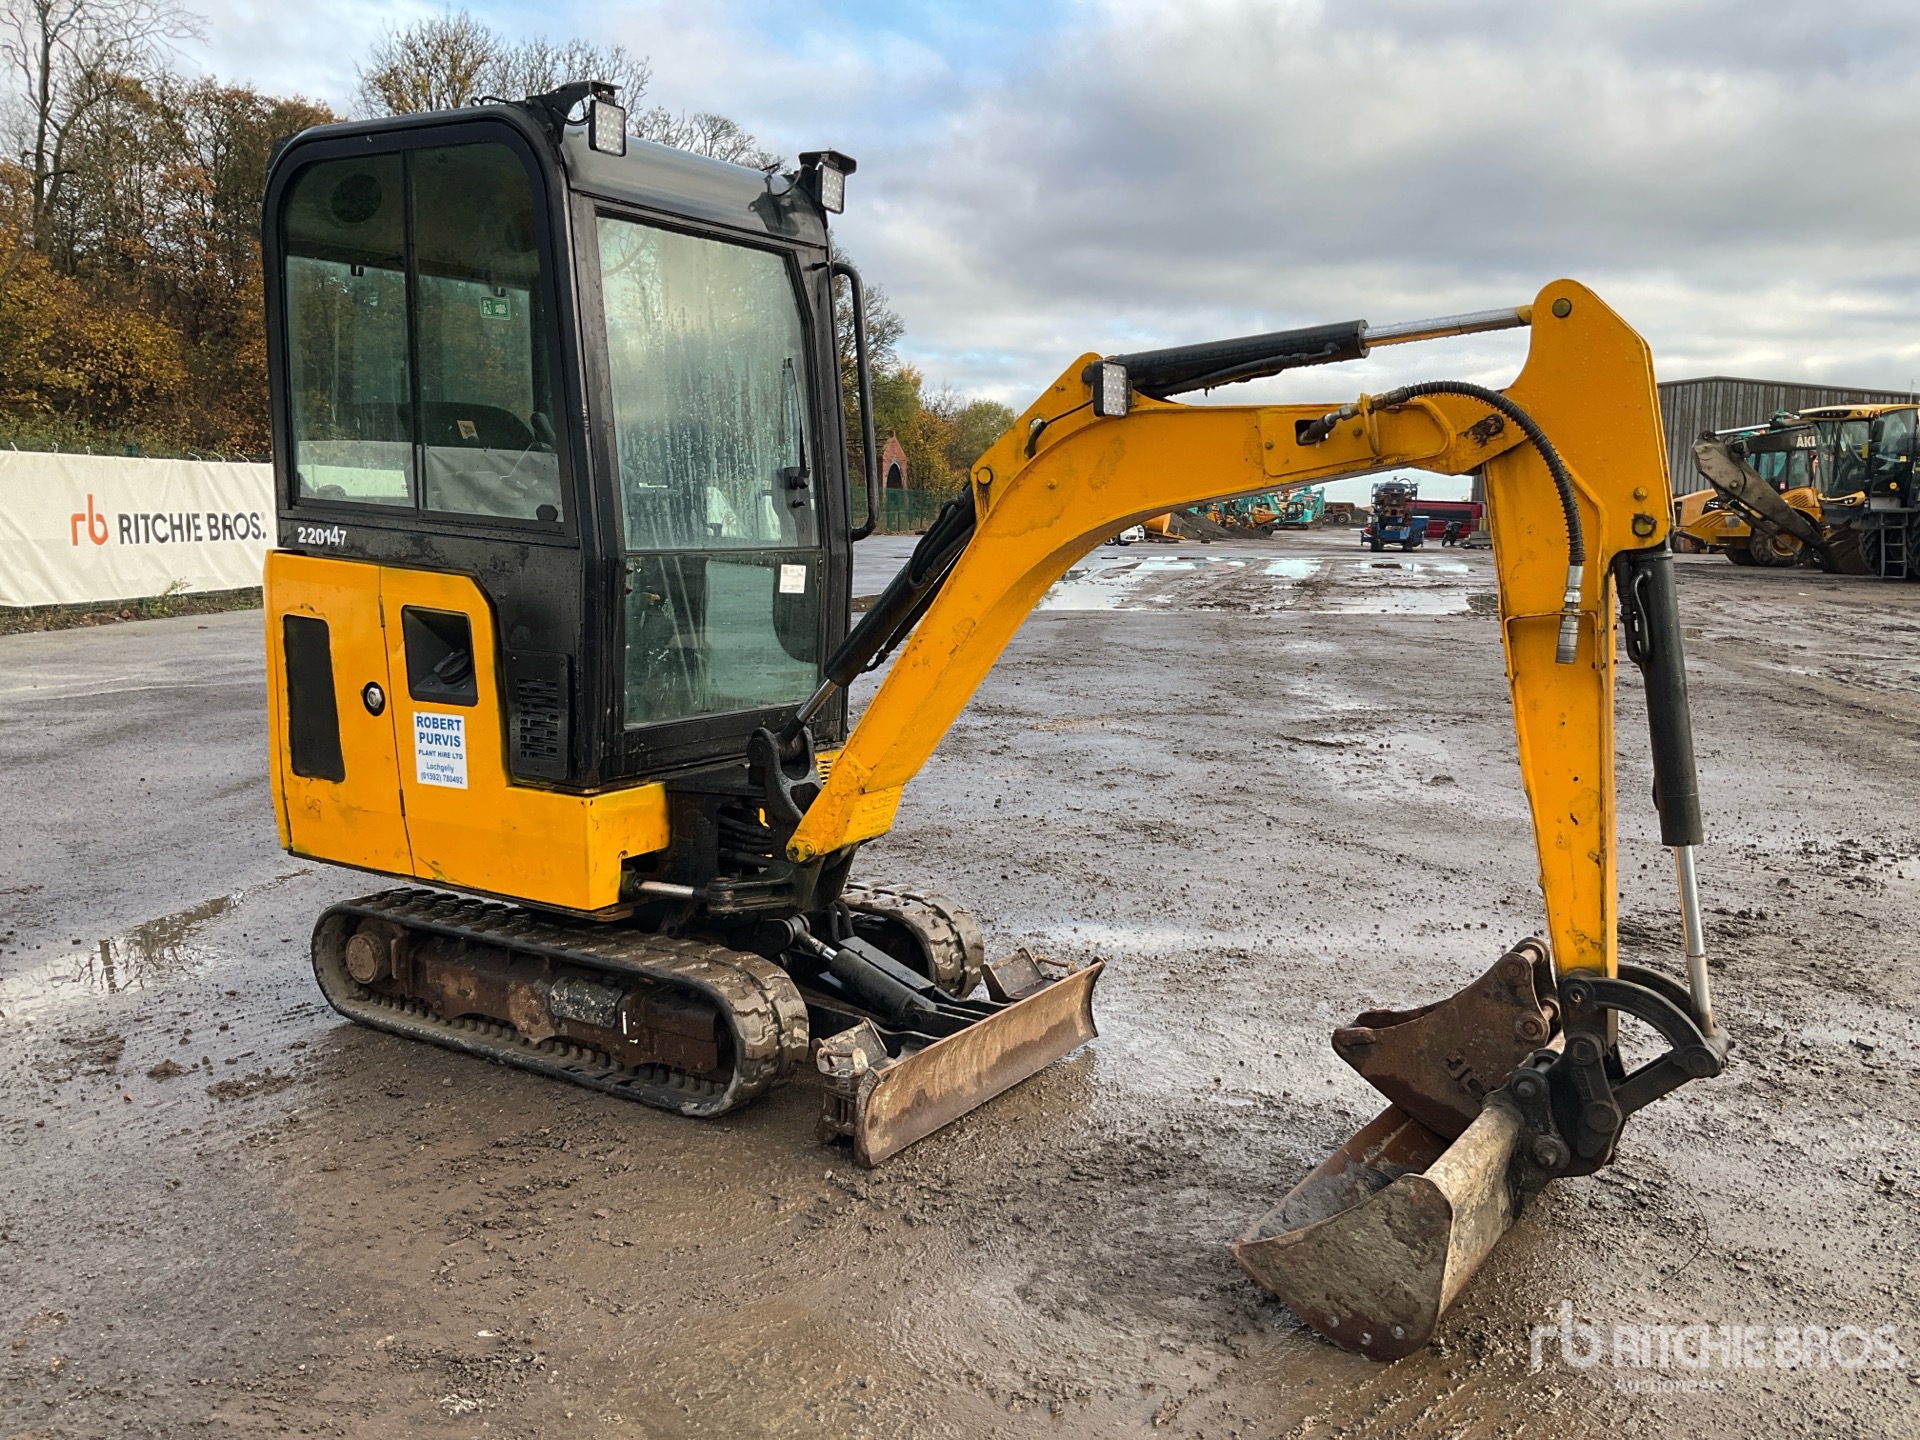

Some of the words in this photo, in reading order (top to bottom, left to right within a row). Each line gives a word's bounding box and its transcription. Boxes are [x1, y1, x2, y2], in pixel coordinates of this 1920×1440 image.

[71, 494, 109, 546] rb
[118, 512, 203, 544] RITCHIE
[297, 525, 347, 546] 220147
[416, 716, 462, 731] ROBERT
[419, 732, 461, 747] PURVIS
[418, 749, 436, 757] PLANT
